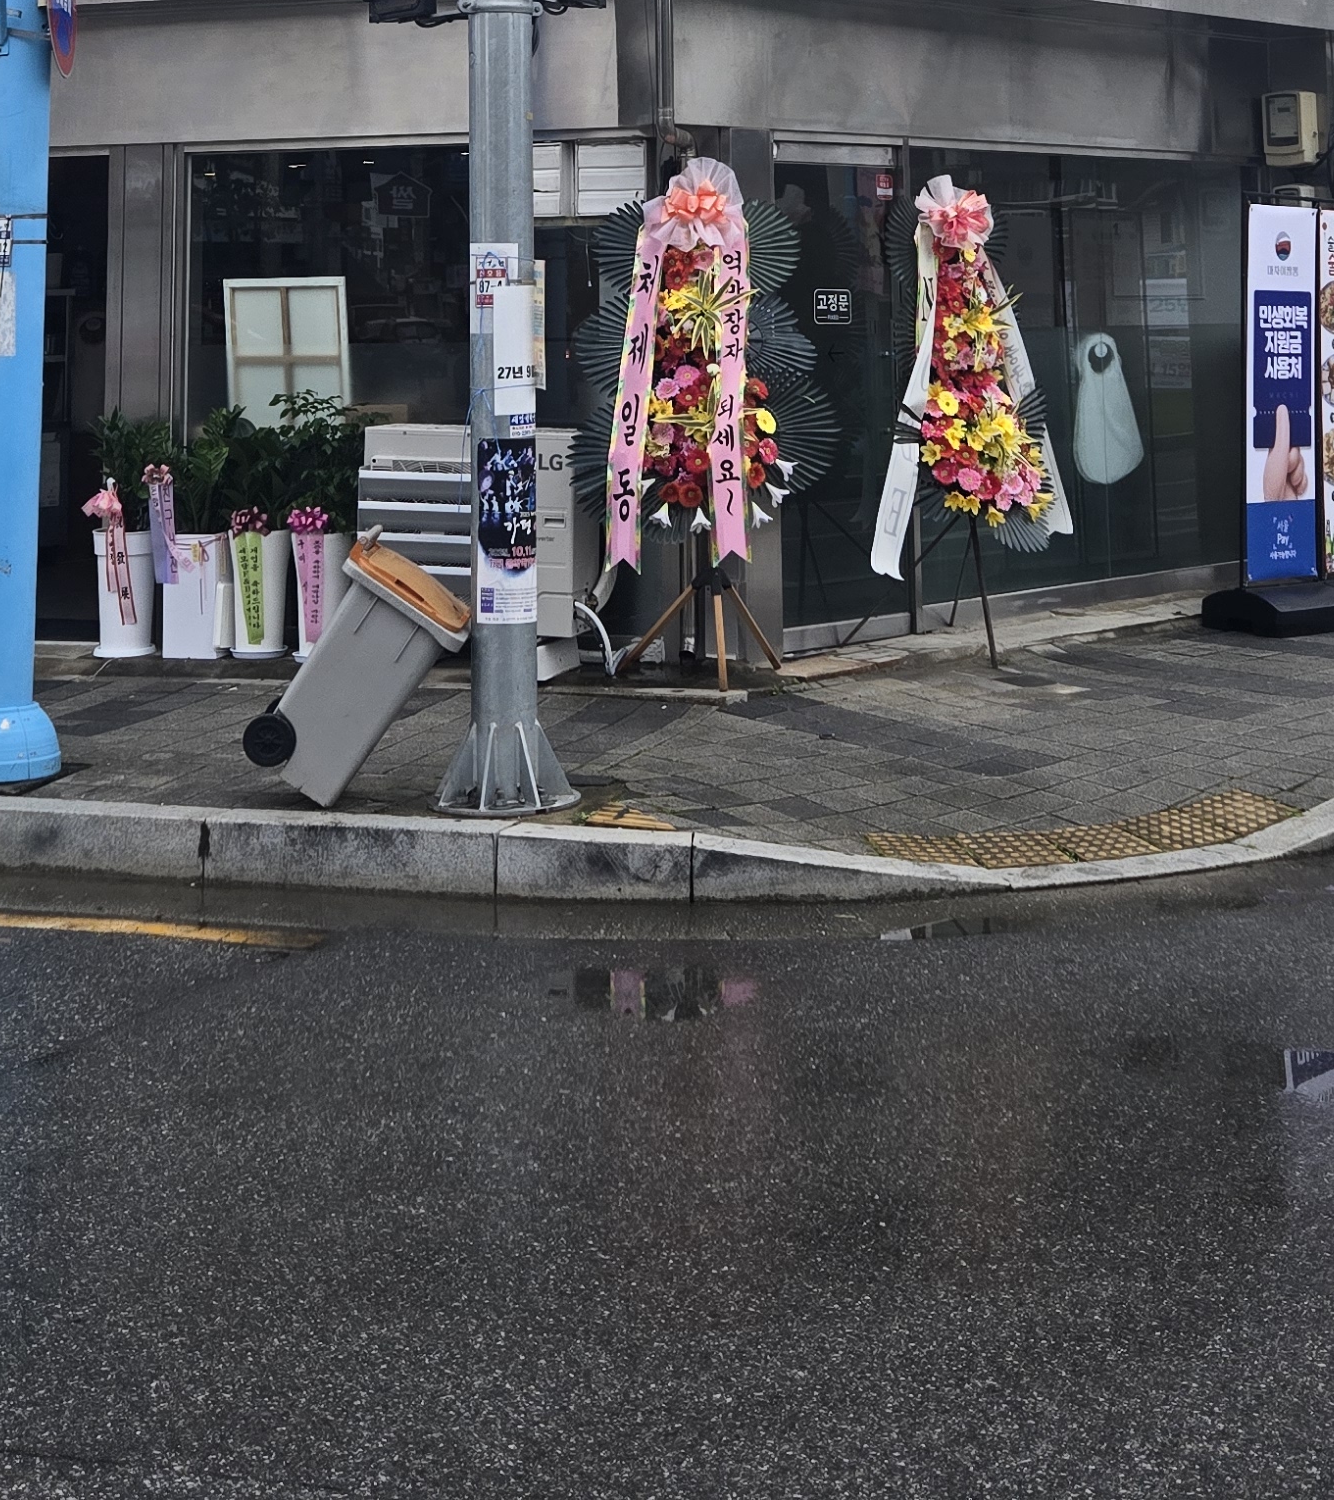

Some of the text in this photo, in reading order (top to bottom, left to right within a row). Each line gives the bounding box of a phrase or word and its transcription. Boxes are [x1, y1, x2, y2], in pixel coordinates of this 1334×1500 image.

[816, 293, 849, 312] 고정문
[1258, 304, 1308, 329] 민생회복
[1264, 330, 1302, 354] 지원금
[497, 366, 523, 379] 27년
[1264, 355, 1302, 379] 사용처
[538, 453, 564, 471] LG
[1276, 532, 1290, 547] Pay
